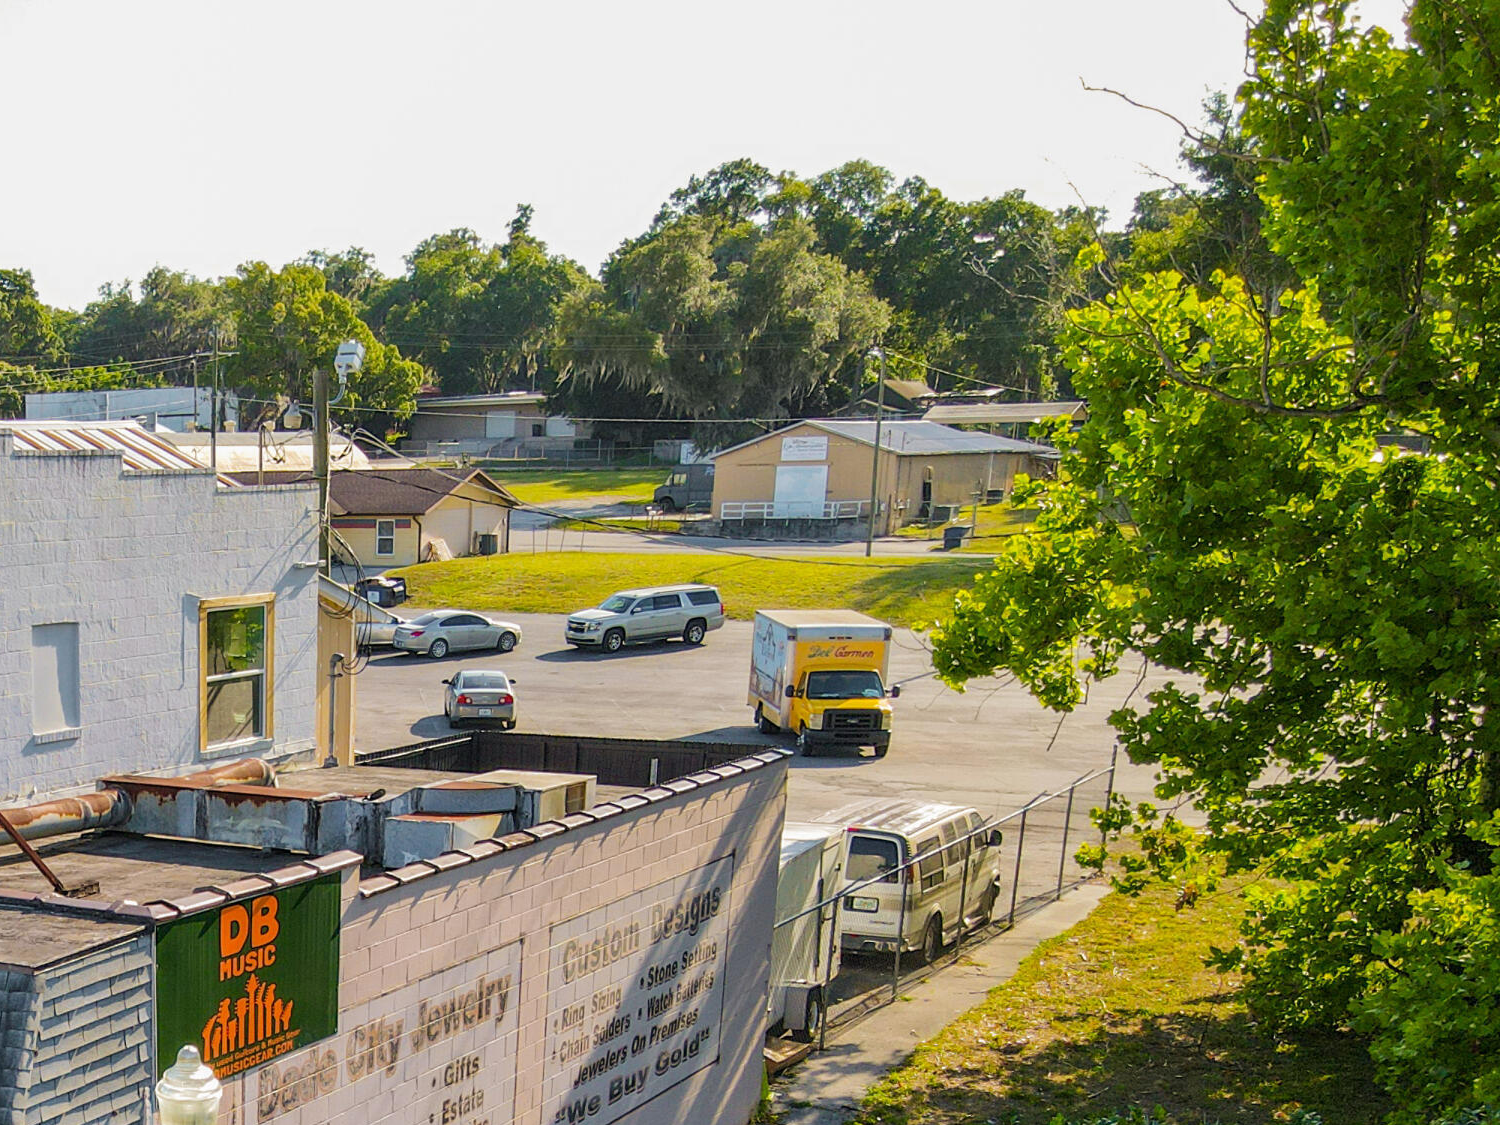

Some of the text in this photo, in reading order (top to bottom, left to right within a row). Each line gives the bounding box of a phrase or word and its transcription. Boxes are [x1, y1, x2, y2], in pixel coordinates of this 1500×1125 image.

[220, 893, 280, 958] DB
[563, 886, 722, 984] Custom Designs
[219, 944, 276, 982] MUSIC
[647, 940, 717, 991] Stone Setting
[560, 987, 622, 1031] Ring Sizing
[647, 971, 714, 1021] Watch Batteries
[258, 973, 513, 1125] Dade City Jewelry
[559, 1013, 631, 1064] Chain Solders
[573, 1006, 700, 1090] Jewelers On Premises
[443, 1054, 481, 1088] Gifts
[608, 1066, 650, 1106] Buy
